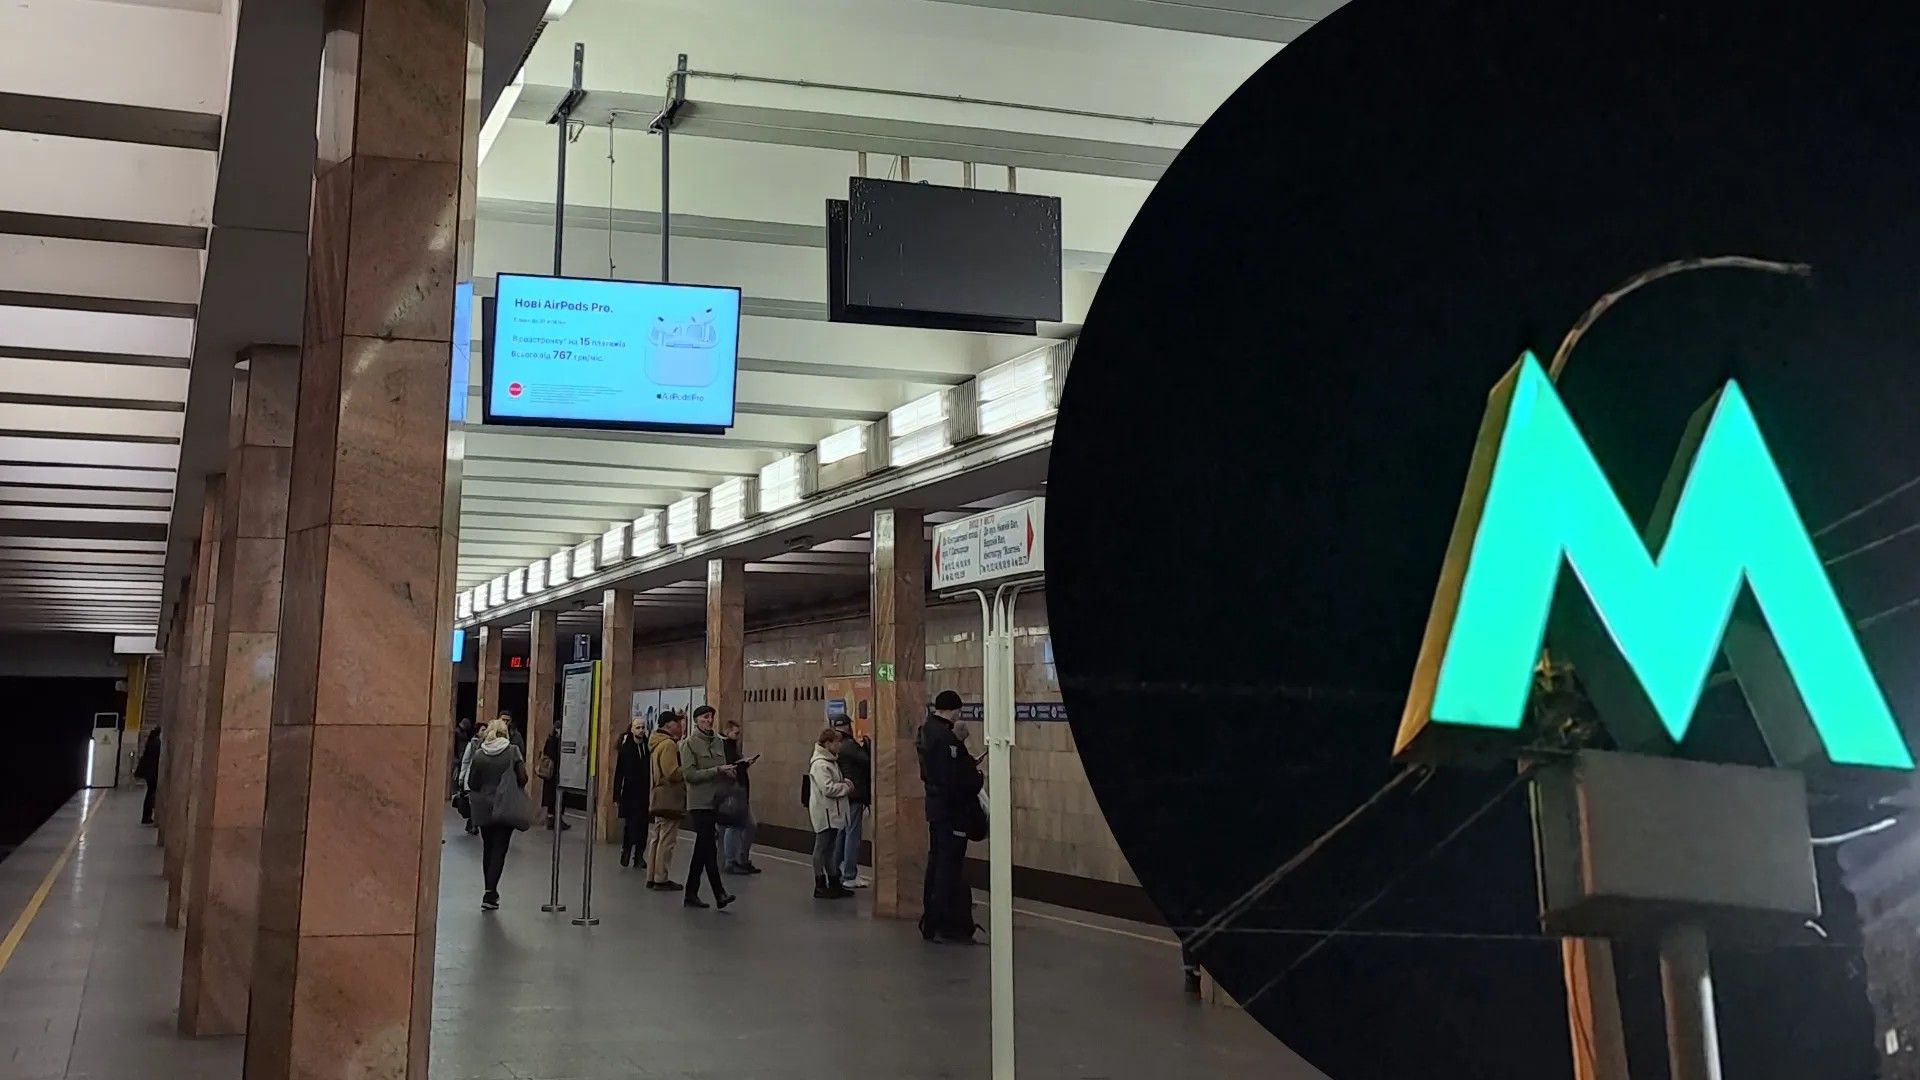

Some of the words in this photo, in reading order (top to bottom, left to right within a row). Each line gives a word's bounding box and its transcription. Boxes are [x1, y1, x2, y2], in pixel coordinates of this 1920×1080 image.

[514, 298, 541, 309] Нові
[544, 299, 589, 312] AirPods
[591, 302, 614, 313] Pro.
[580, 337, 591, 346] 15
[553, 350, 573, 360] 767
